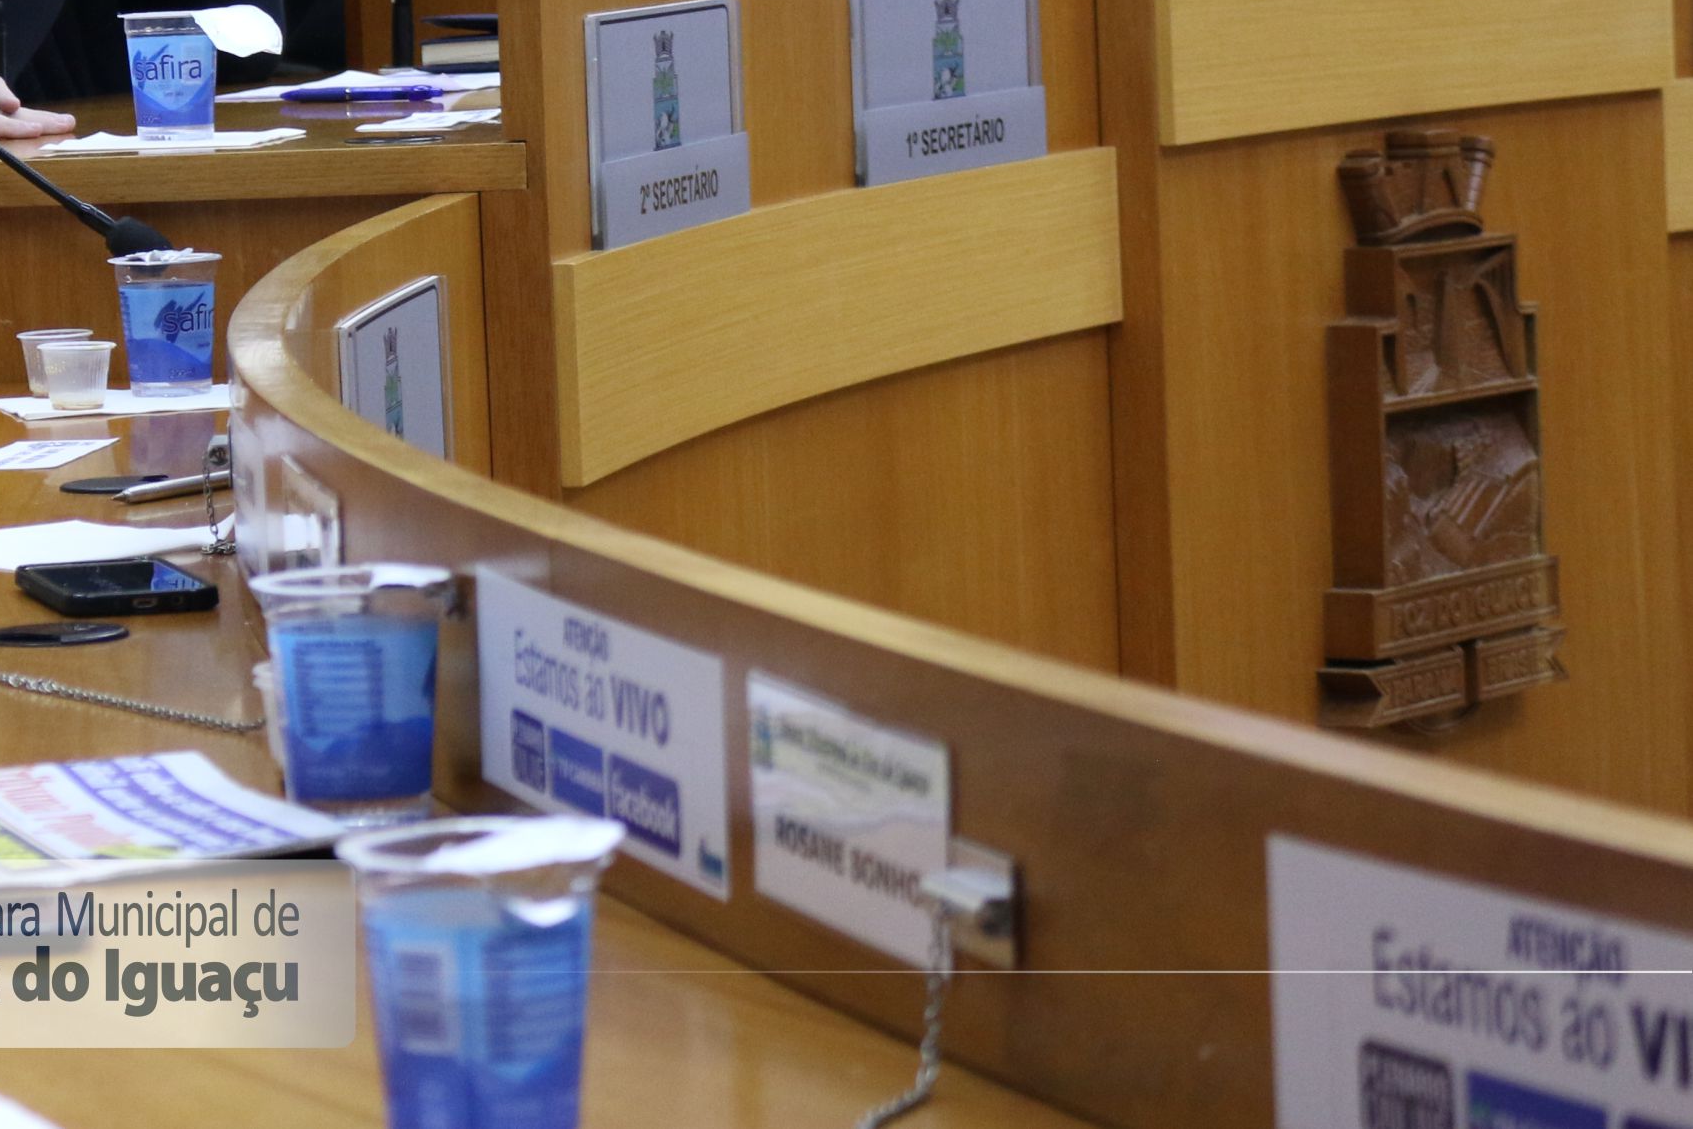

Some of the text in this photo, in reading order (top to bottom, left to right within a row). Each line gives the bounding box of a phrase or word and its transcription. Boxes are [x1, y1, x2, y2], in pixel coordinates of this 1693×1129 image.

[135, 54, 202, 81] safira
[921, 114, 1004, 156] SECRETÁRIO
[652, 164, 718, 212] SECRETÁRIO
[515, 628, 671, 748] Estamos ao VIVO
[1372, 925, 1547, 1053] Estamos
[1560, 993, 1616, 1071] ao
